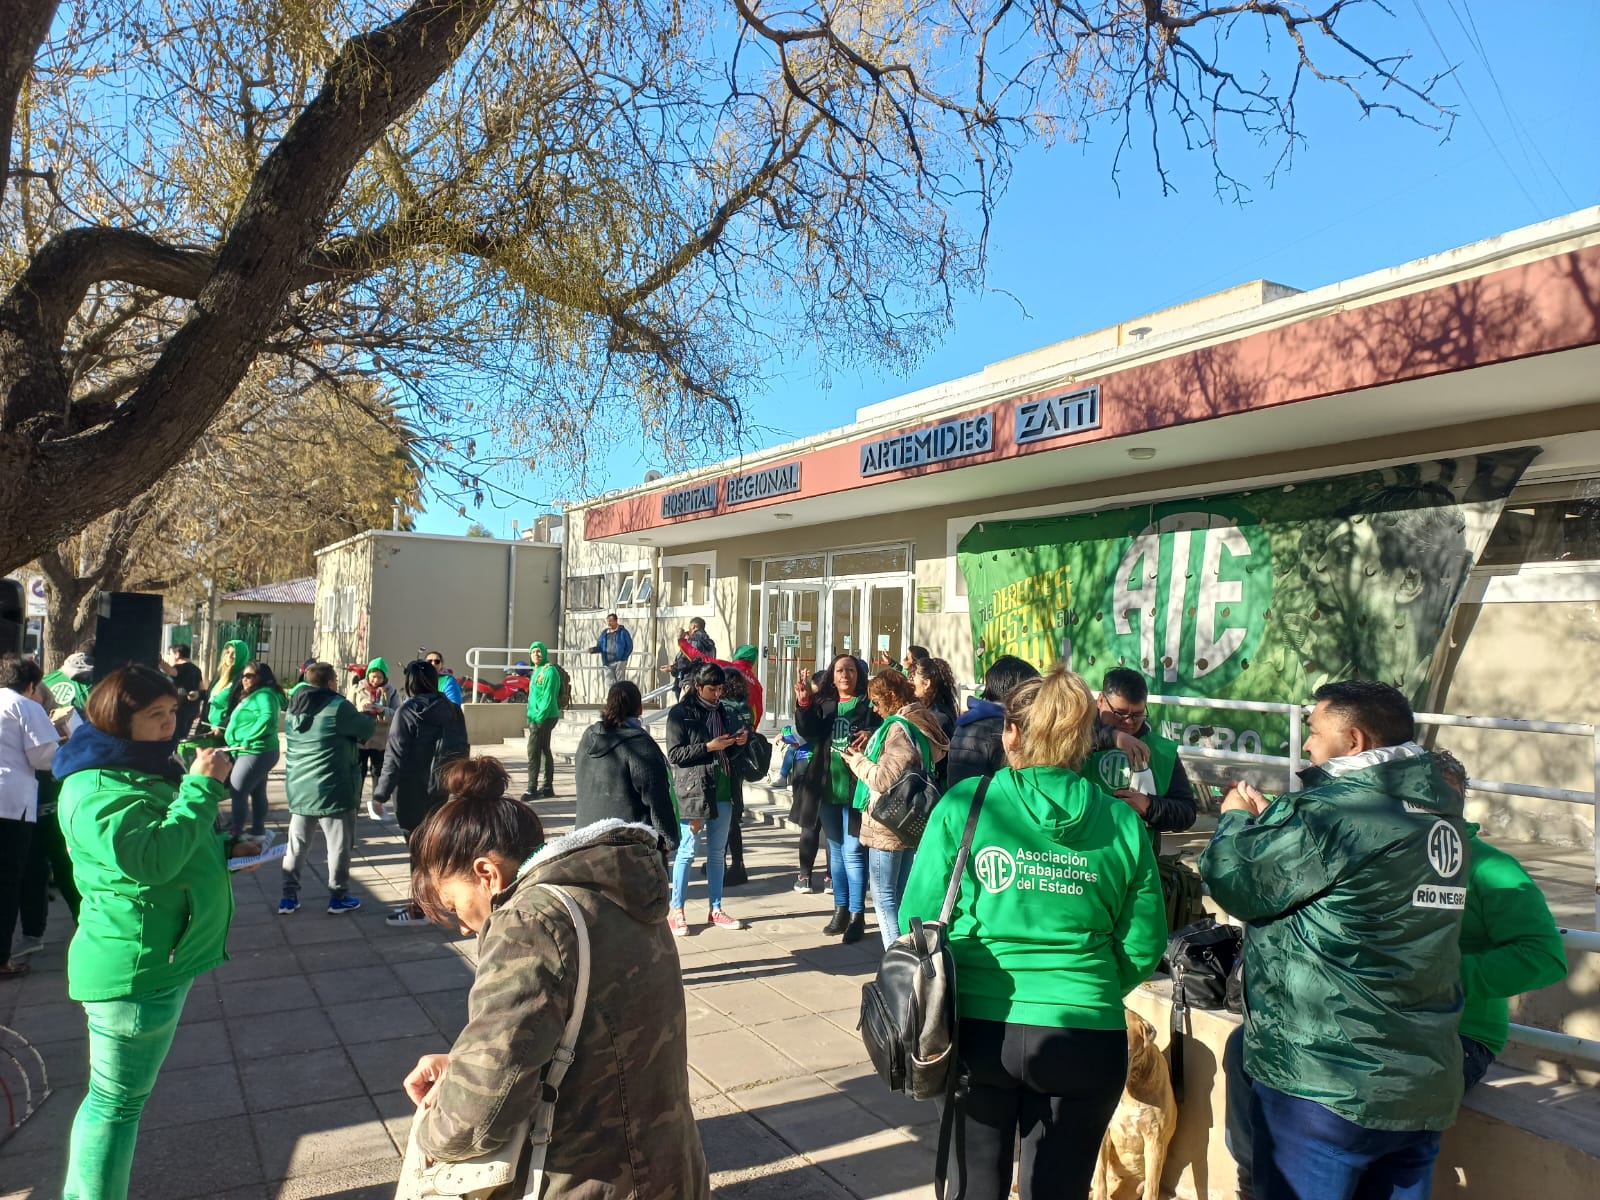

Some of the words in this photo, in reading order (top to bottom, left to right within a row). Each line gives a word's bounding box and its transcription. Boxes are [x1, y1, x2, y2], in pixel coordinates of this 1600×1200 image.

[662, 485, 714, 517] HOSPITAL
[726, 465, 798, 503] REGIONAL
[862, 416, 989, 473] ARTEMIDES
[1019, 389, 1097, 439] ZATTI
[992, 564, 1072, 618] DERECHOS
[1113, 511, 1251, 683] ATE
[1015, 847, 1088, 867] Asociación
[1430, 823, 1459, 874] ATE
[977, 850, 1011, 890] ATE
[1015, 861, 1098, 882] Trabajadores
[1016, 878, 1035, 890] del
[1039, 879, 1084, 895] Estado
[1417, 888, 1437, 903] RÍO
